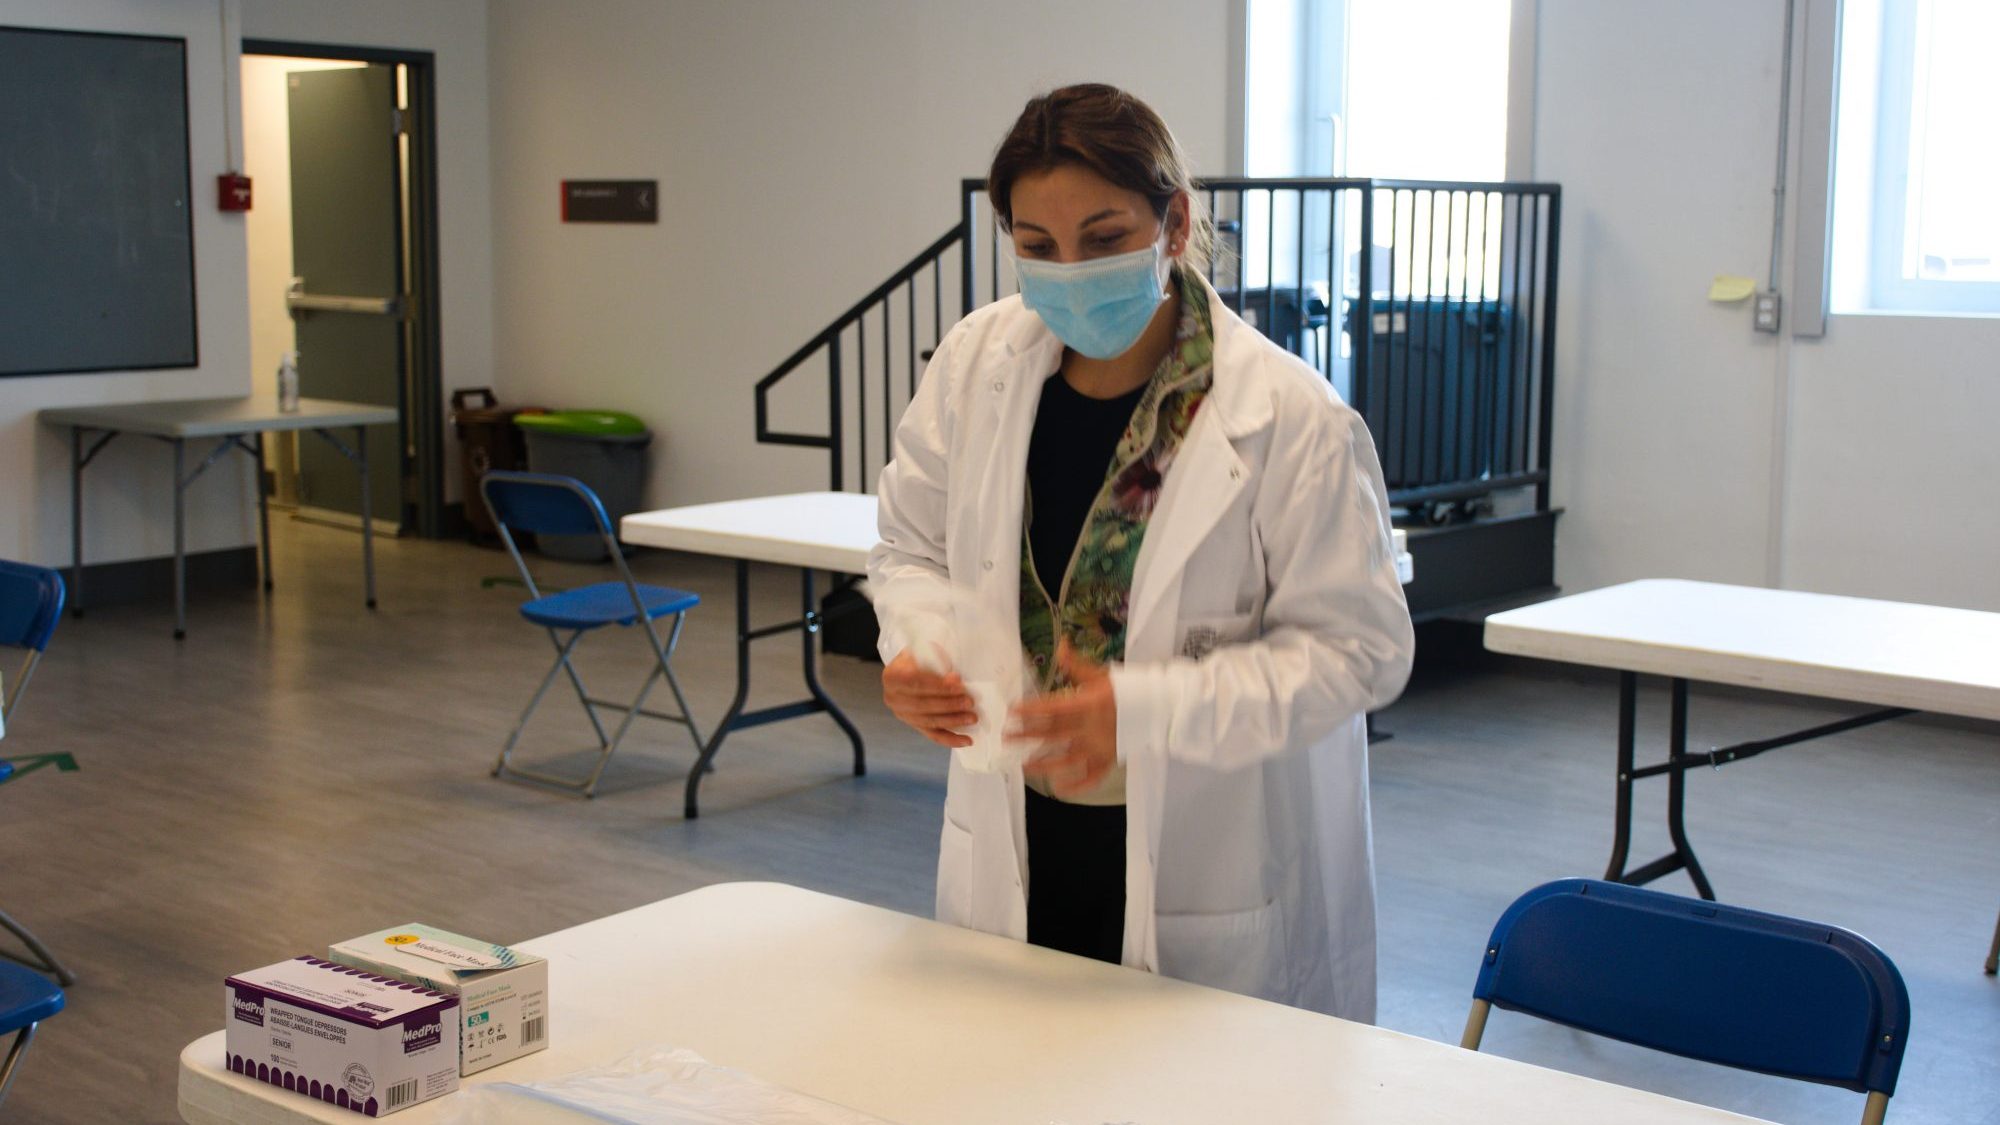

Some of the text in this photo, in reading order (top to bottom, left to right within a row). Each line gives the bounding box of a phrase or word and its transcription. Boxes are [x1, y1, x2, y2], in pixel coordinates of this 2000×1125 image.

[233, 996, 265, 1016] MedPro
[270, 1007, 294, 1020] WRAPPED
[294, 1013, 314, 1026] TONGUE
[314, 1018, 347, 1036] DEPRESSORS
[401, 1023, 442, 1043] MedPro
[272, 1038, 292, 1050] SENIOR
